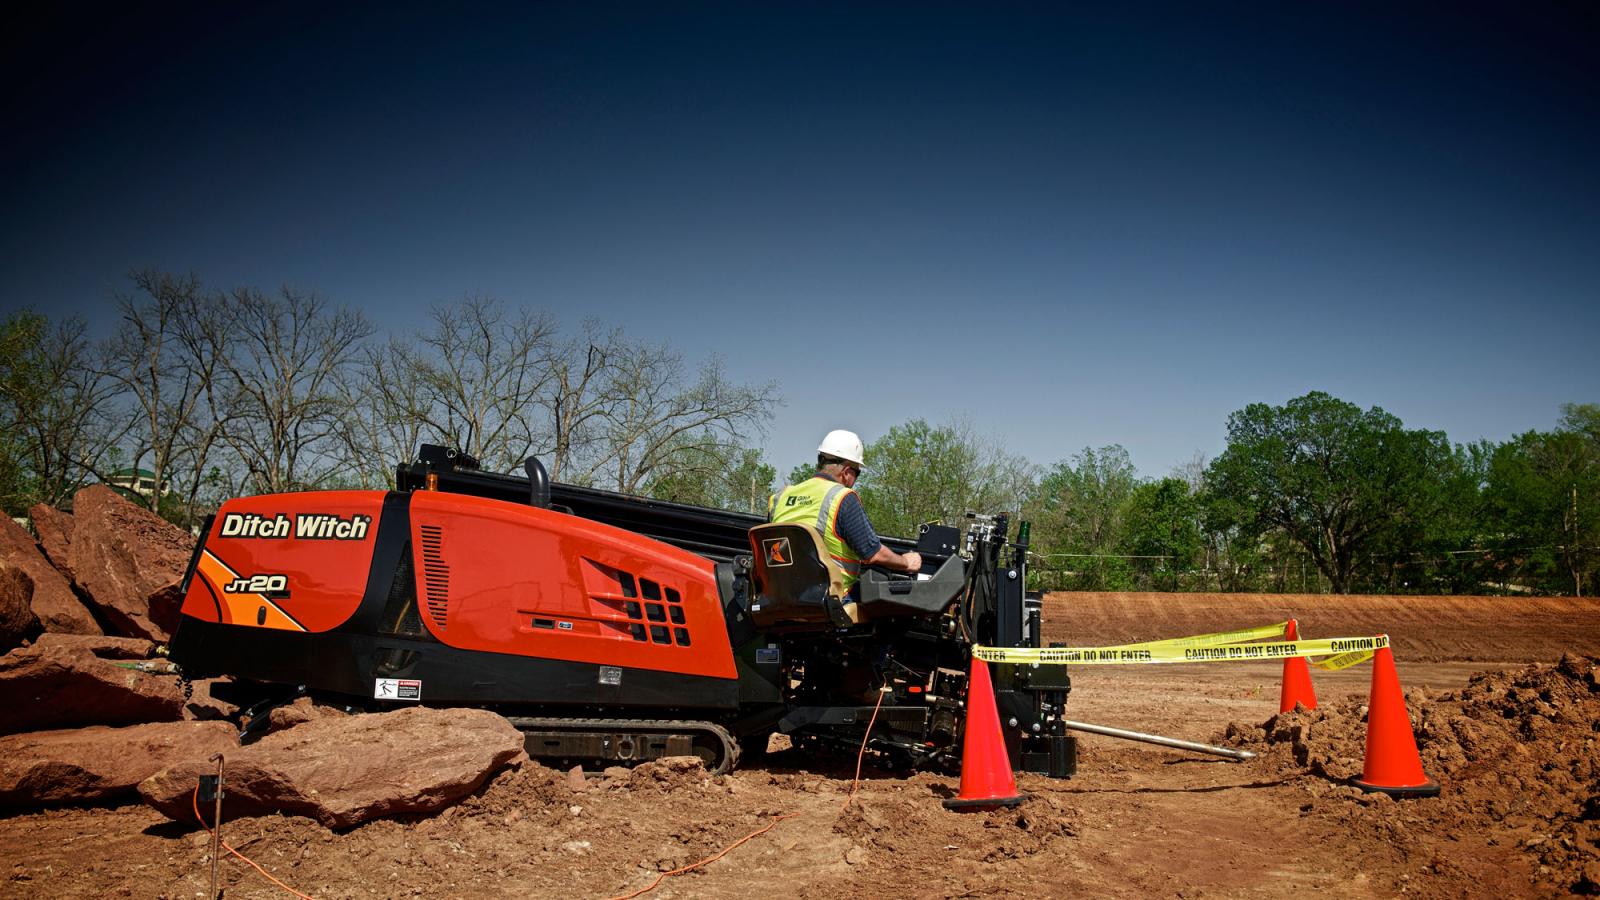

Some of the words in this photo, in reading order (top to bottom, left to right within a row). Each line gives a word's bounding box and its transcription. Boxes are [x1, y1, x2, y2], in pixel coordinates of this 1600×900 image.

[221, 514, 291, 538] Ditch
[296, 515, 368, 539] Witch
[225, 574, 288, 593] JT20
[1184, 648, 1227, 661] CAUTION
[1229, 647, 1243, 659] DO
[1244, 646, 1264, 658] NOT
[1265, 644, 1299, 657] ENTER
[1330, 638, 1374, 652] CAUTION
[1039, 650, 1081, 662] CAUTION
[1083, 650, 1097, 662] DO
[1099, 650, 1118, 662] NOT
[1120, 650, 1152, 662] ENTER
